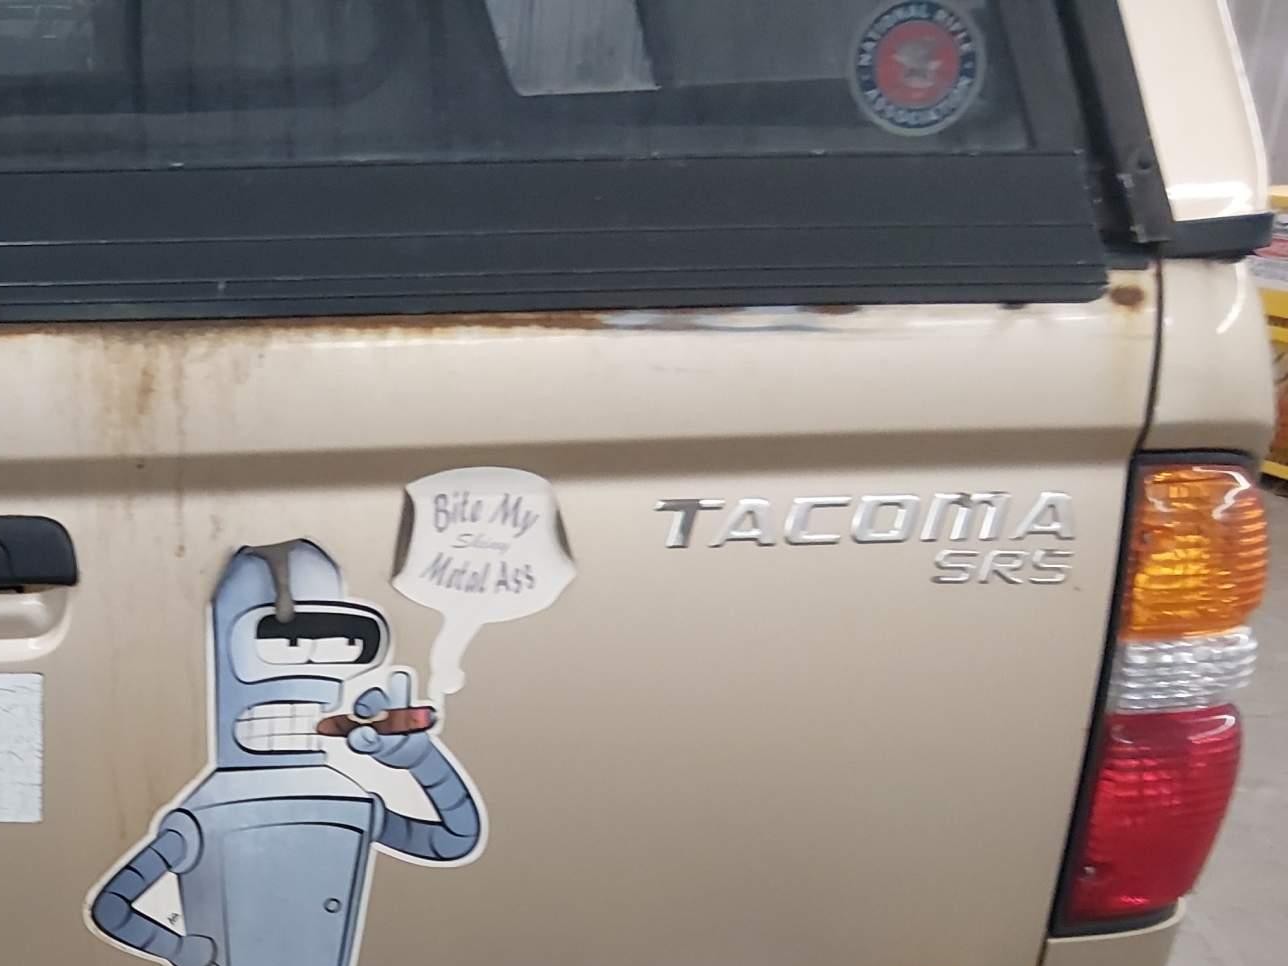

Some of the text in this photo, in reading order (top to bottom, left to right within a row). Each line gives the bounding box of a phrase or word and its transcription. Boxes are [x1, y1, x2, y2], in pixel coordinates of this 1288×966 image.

[432, 491, 540, 538] Bite My
[653, 491, 1076, 549] TACOMA
[419, 552, 490, 593] Metal
